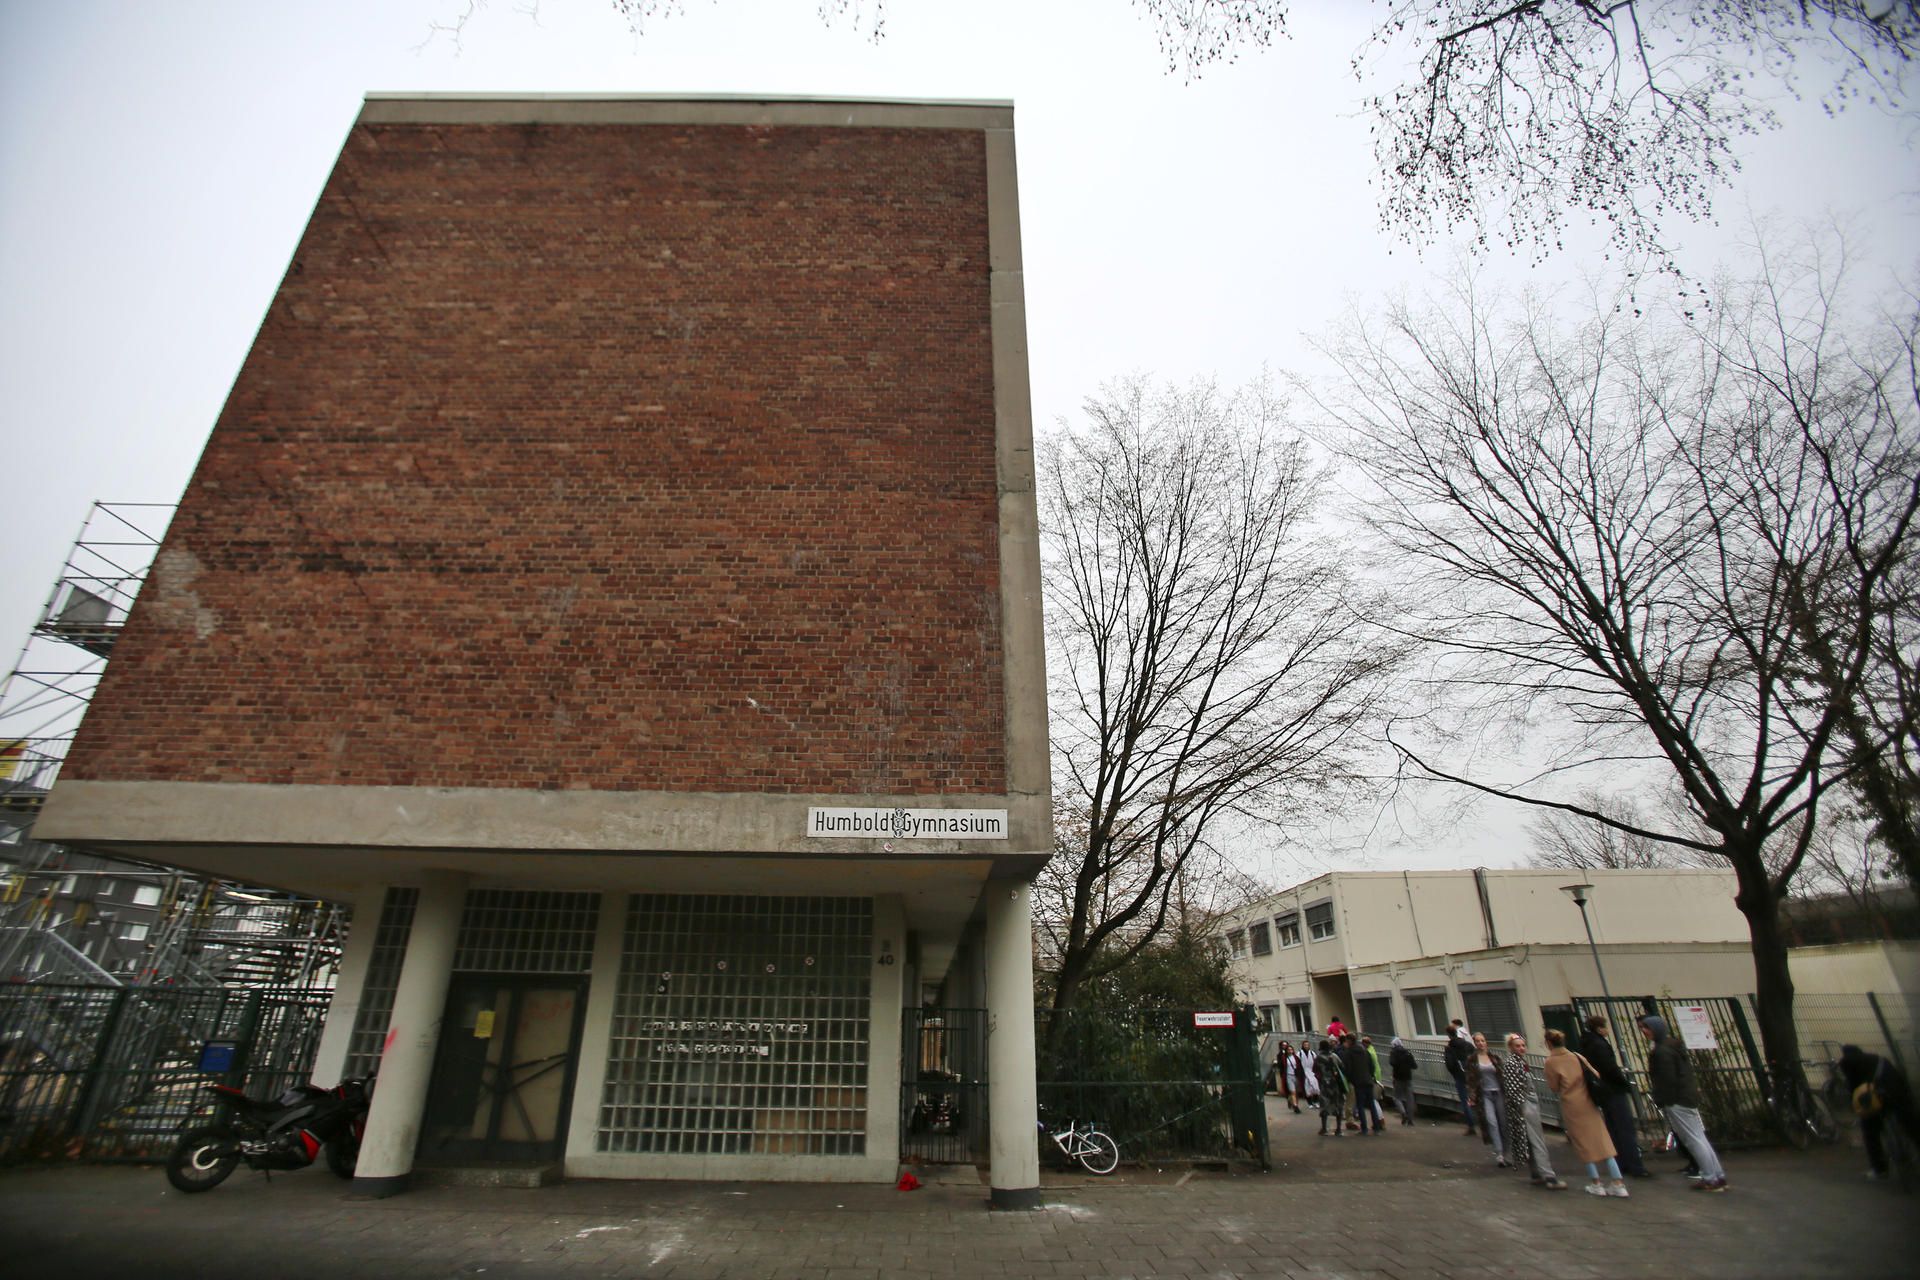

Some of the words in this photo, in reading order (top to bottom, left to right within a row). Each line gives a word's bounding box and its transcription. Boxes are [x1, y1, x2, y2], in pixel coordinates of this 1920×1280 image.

[815, 811, 895, 832] Humboldt
[903, 813, 1000, 837] Gymnasium
[877, 955, 894, 966] 40
